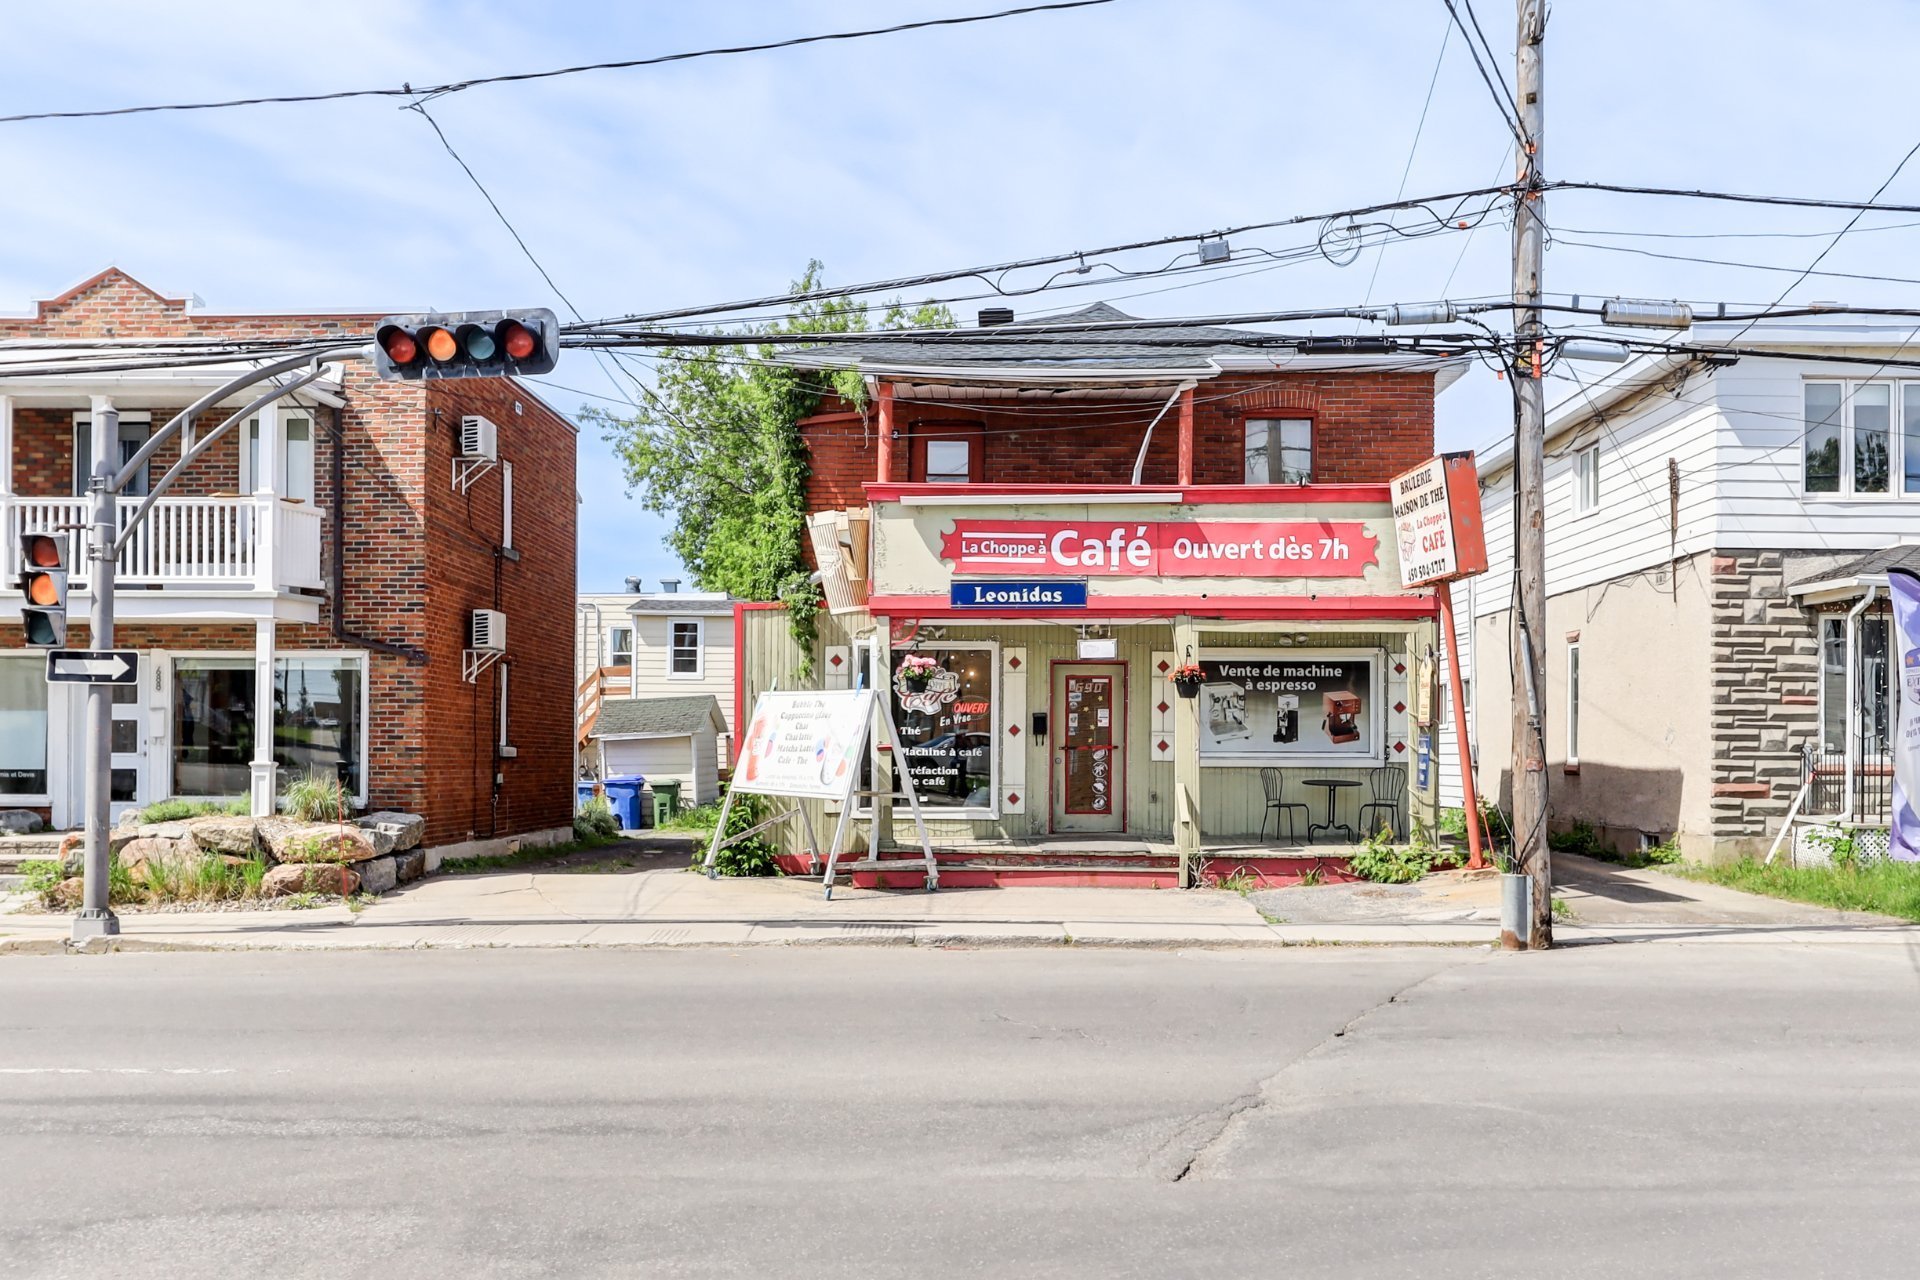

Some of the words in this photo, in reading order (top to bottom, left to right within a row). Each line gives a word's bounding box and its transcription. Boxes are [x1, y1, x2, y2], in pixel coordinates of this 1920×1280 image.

[1394, 497, 1418, 519] MAISON
[1420, 494, 1429, 508] DE
[1430, 483, 1445, 505] THÉ
[1416, 520, 1423, 529] La
[1423, 512, 1442, 528] Choppe
[1442, 509, 1447, 519] à
[1422, 525, 1446, 553] CAFÉ
[961, 541, 978, 553] La
[981, 541, 1035, 557] Choppe
[1038, 540, 1047, 555] à
[1051, 525, 1152, 571] Café
[1173, 538, 1264, 560] Ouvert
[1269, 536, 1313, 560] dès
[1318, 538, 1349, 560] 7h
[1407, 567, 1418, 582] 450
[1419, 558, 1446, 579] 504-1717
[974, 586, 1063, 603] Leonidas
[1219, 664, 1260, 677] Vente
[1263, 664, 1280, 677] de
[1283, 664, 1343, 677] machine
[1075, 682, 1104, 693] 690
[1245, 679, 1253, 690] à
[1256, 681, 1316, 693] espresso
[953, 702, 989, 714] OUVERT
[940, 716, 951, 727] En
[953, 713, 972, 725] Vrac
[900, 726, 921, 735] Thé
[901, 748, 947, 757] Machine
[949, 747, 957, 757] à
[959, 747, 983, 757] café
[893, 765, 958, 775] Tréfaction
[922, 776, 946, 786] café
